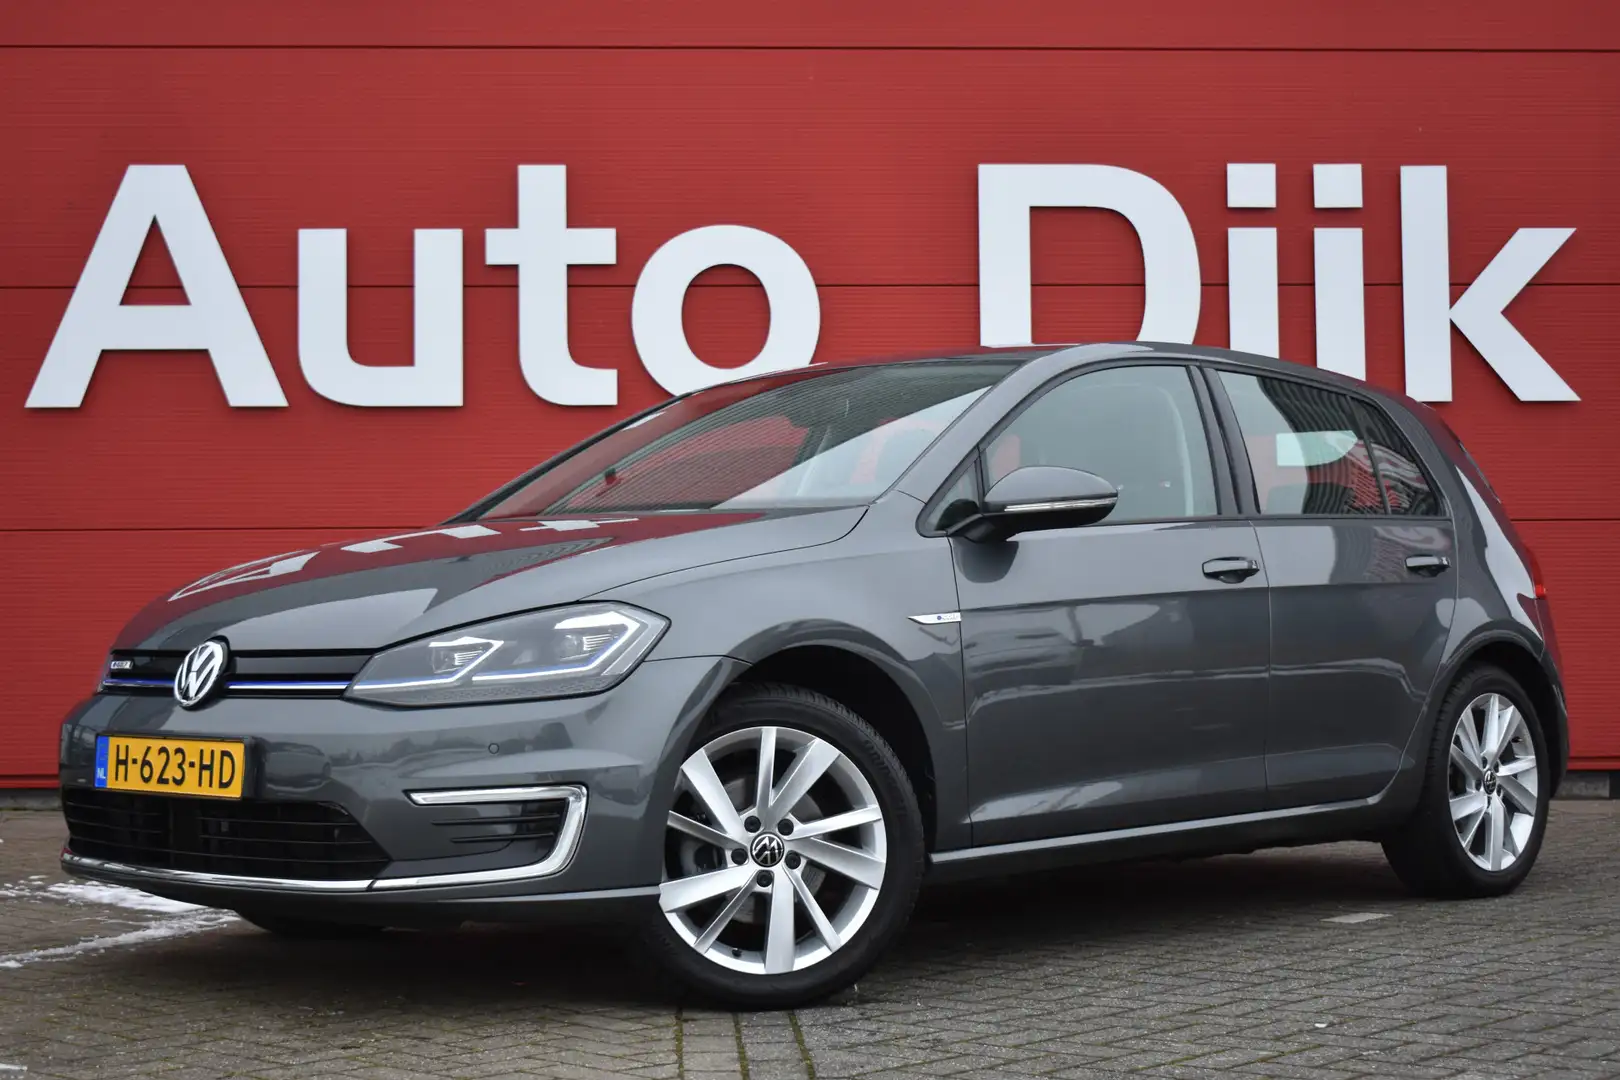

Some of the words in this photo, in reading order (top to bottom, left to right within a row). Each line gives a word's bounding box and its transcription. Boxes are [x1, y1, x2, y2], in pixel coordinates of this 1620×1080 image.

[26, 164, 821, 408] Auto
[96, 767, 107, 780] NL
[115, 744, 236, 789] H-623-HD
